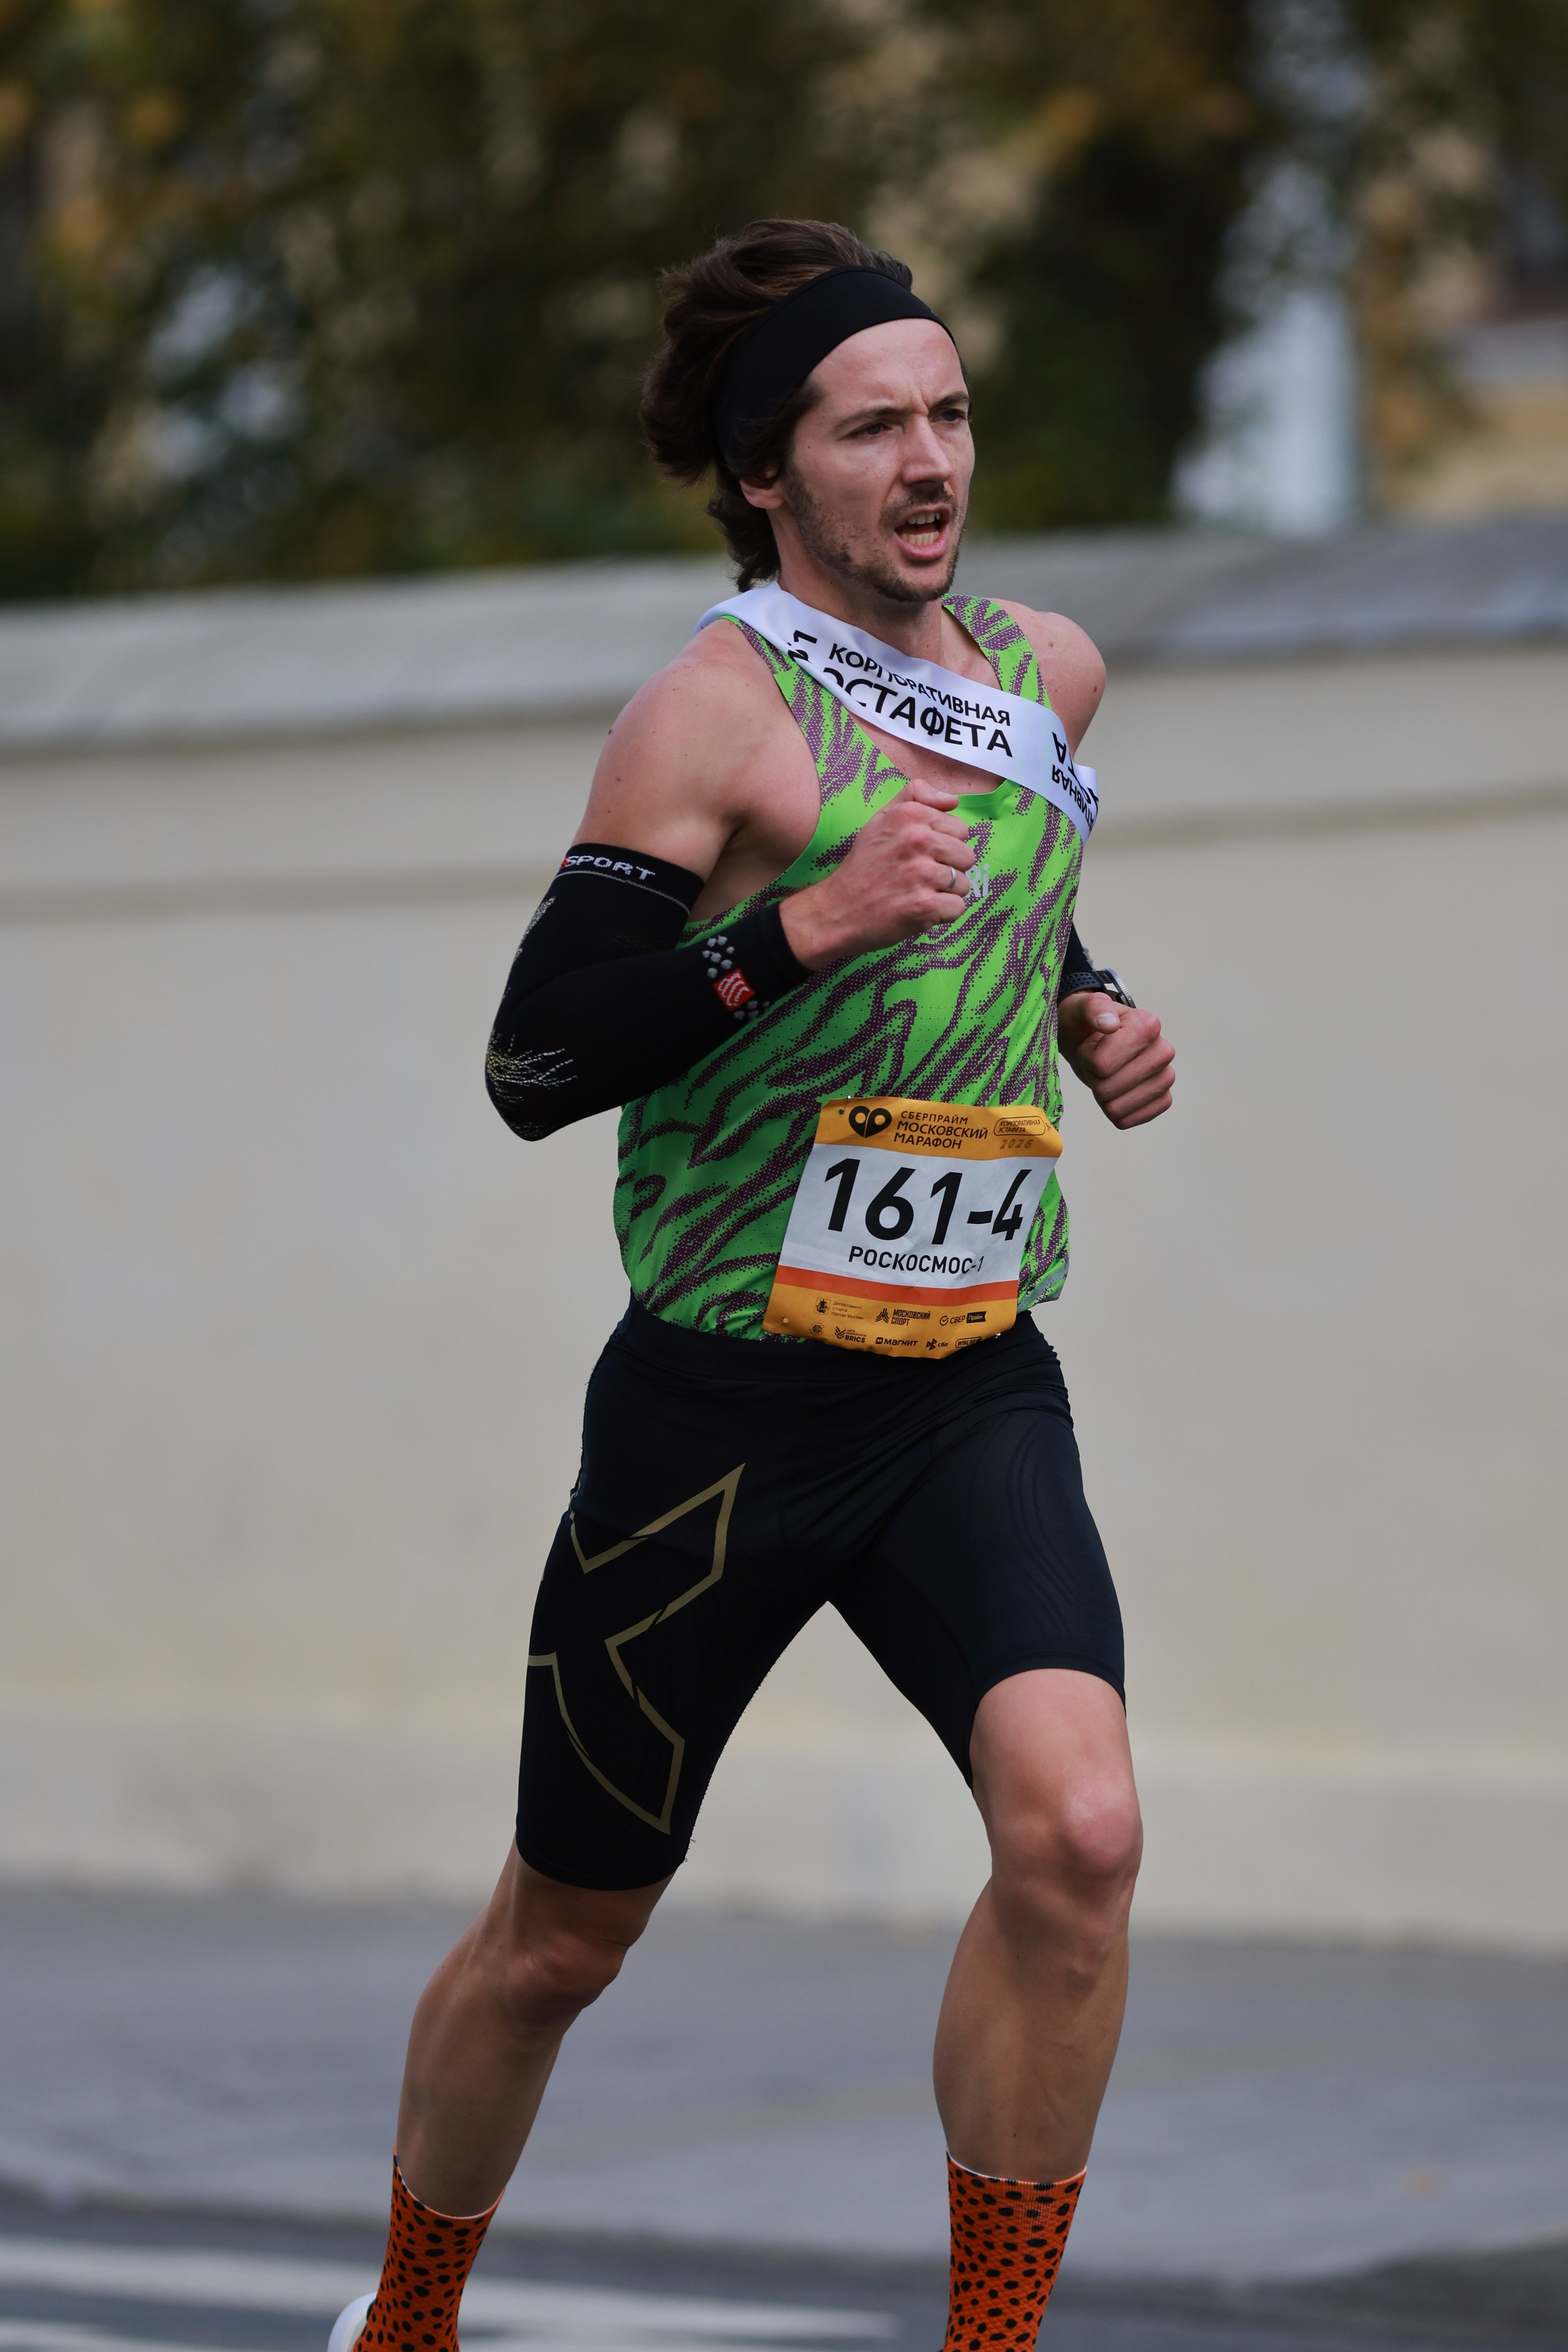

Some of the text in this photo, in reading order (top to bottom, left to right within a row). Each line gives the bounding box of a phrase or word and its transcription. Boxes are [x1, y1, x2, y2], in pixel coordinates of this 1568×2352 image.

[829, 643, 1011, 727] КОРПОРАТИВНАЯ
[560, 855, 656, 880] SPORT
[901, 1110, 968, 1125] СБЕРПРАЙМ
[897, 1120, 989, 1139] МОСКОВСКИЙ
[894, 1133, 962, 1149] МАРАФОН
[824, 1158, 1033, 1245] 161-4
[848, 1245, 985, 1275] РОСКОСМОС-1
[833, 1301, 862, 1310] Департамент
[891, 1317, 910, 1326] СПОРТ
[892, 1309, 931, 1320] МОСКОВСКИЙ
[950, 1315, 966, 1324] СБЕР
[845, 1335, 865, 1343] BRICS
